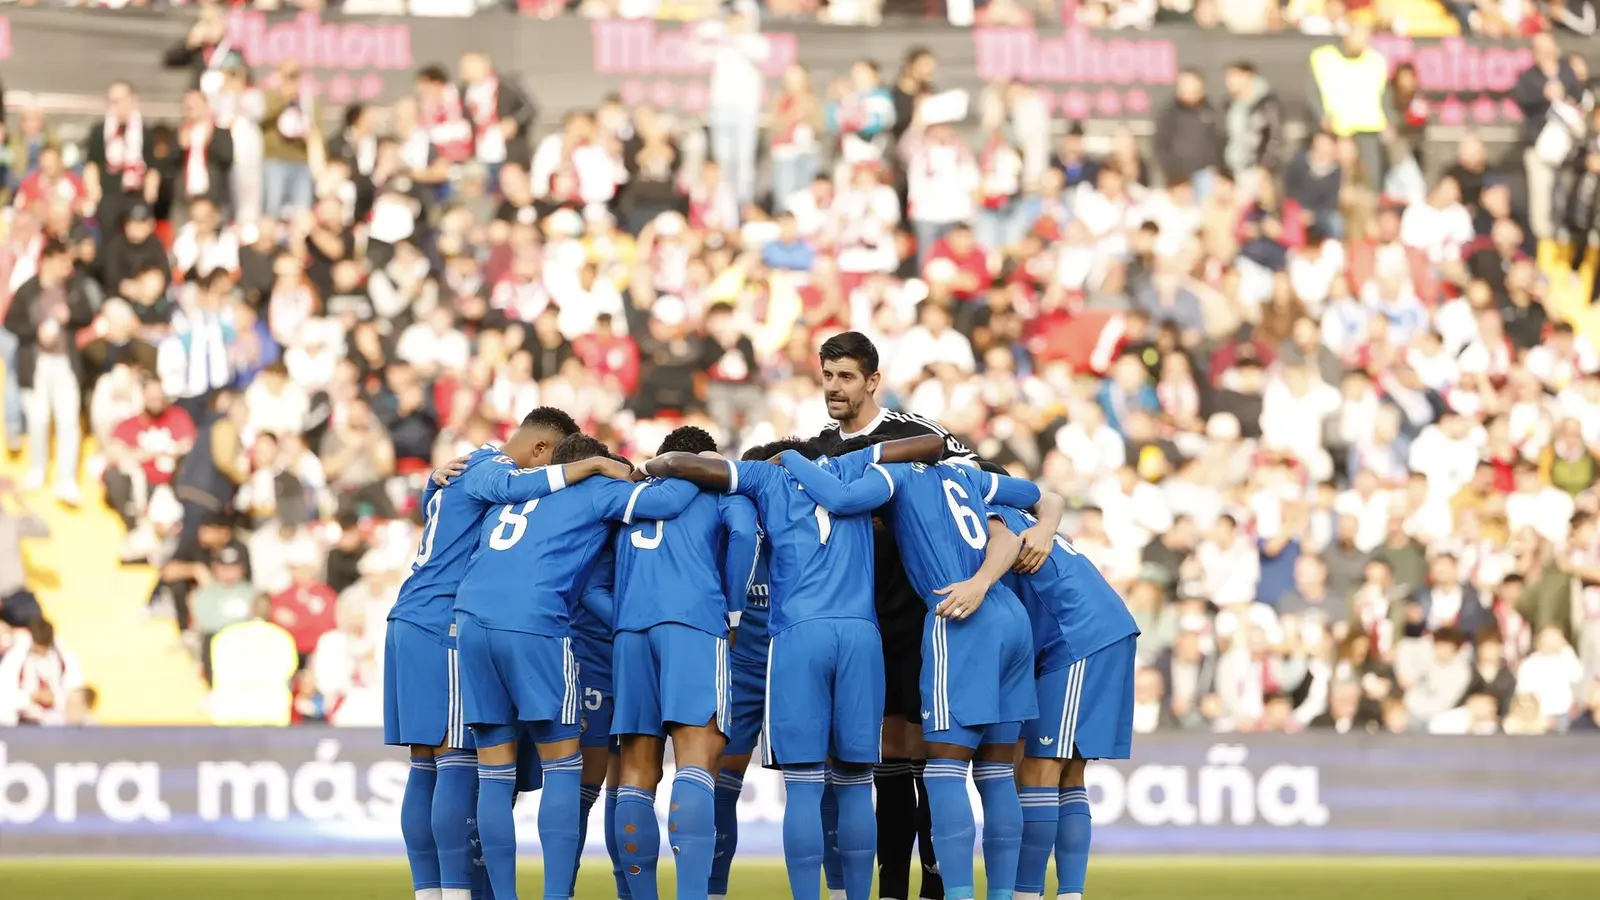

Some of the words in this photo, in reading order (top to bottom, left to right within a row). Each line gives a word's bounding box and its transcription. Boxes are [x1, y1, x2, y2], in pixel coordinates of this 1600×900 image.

[974, 26, 1177, 83] Mahou
[488, 498, 540, 551] 8
[942, 478, 987, 550] 6
[198, 737, 410, 823] más
